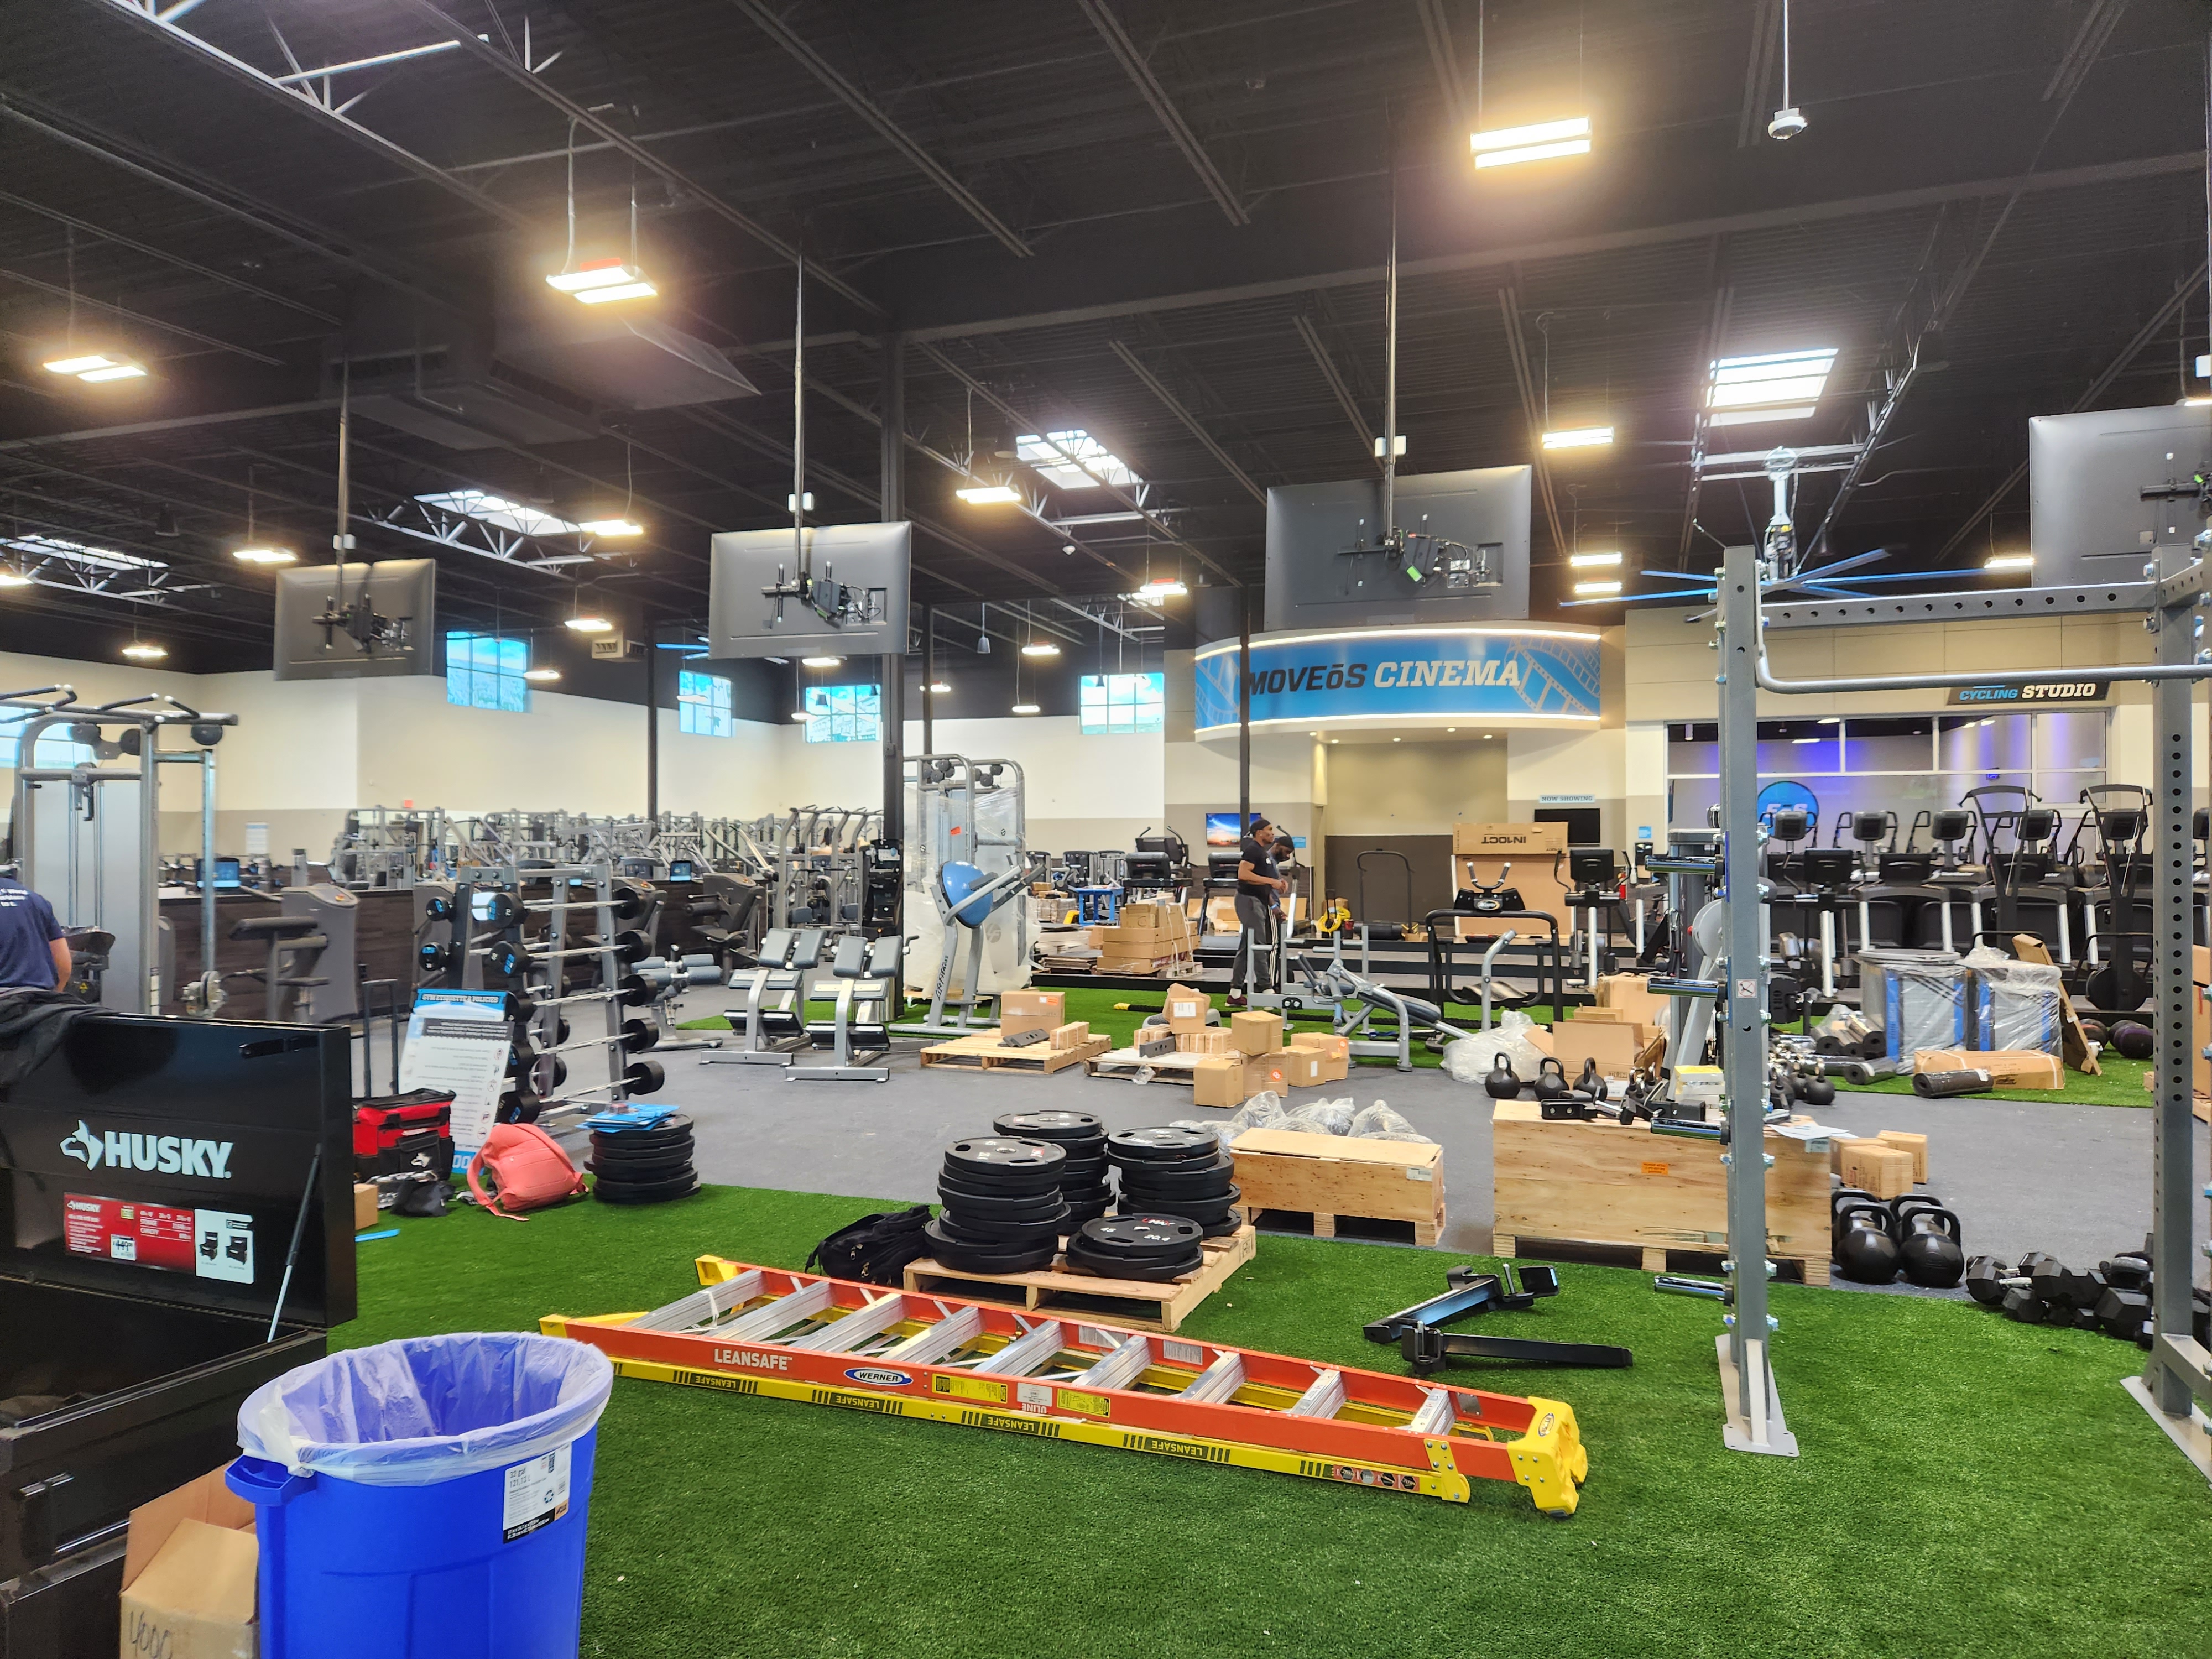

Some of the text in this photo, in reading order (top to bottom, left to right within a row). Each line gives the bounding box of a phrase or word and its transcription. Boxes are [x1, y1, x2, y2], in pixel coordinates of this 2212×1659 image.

[1374, 660, 1520, 687] CINEMA
[1959, 683, 2096, 700] CYCLING STUDIO
[104, 1131, 233, 1178] HUSKY
[75, 1202, 101, 1213] HUSKY
[695, 1375, 736, 1389] LEANSAFE
[859, 1371, 899, 1382] WERNER
[836, 1395, 879, 1409] LEANSAFE
[1022, 1403, 1047, 1414] ULINE
[987, 1417, 1034, 1431] LEANSAFE
[1151, 1440, 1203, 1456] LEANSAFE
[509, 1470, 517, 1479] 32
